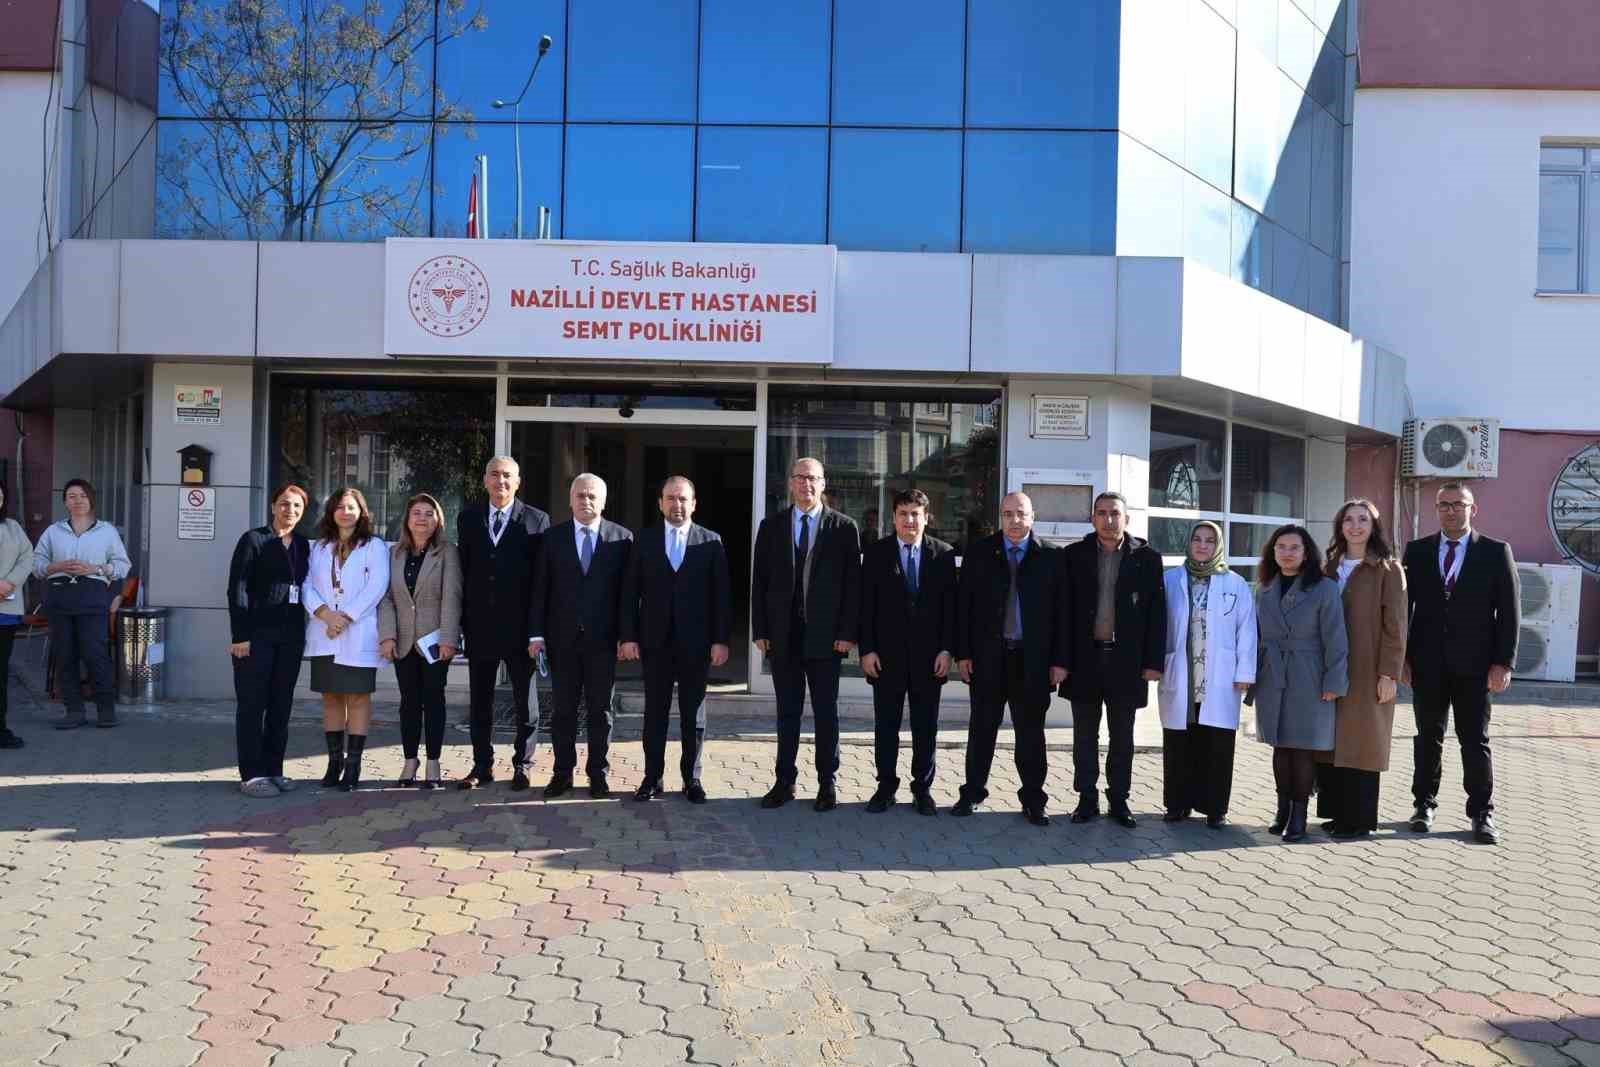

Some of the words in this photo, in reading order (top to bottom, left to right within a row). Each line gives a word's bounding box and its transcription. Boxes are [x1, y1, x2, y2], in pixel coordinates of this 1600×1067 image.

[571, 258, 604, 276] T.C.
[610, 260, 666, 281] Sağlık
[672, 261, 755, 283] Bakanlığı
[511, 285, 594, 309] NAZİLLİ
[602, 291, 685, 312] DEVLET
[692, 290, 816, 313] HASTANESİ
[563, 321, 623, 340] SEMT
[629, 318, 761, 343] POLİKLİNİĞİ
